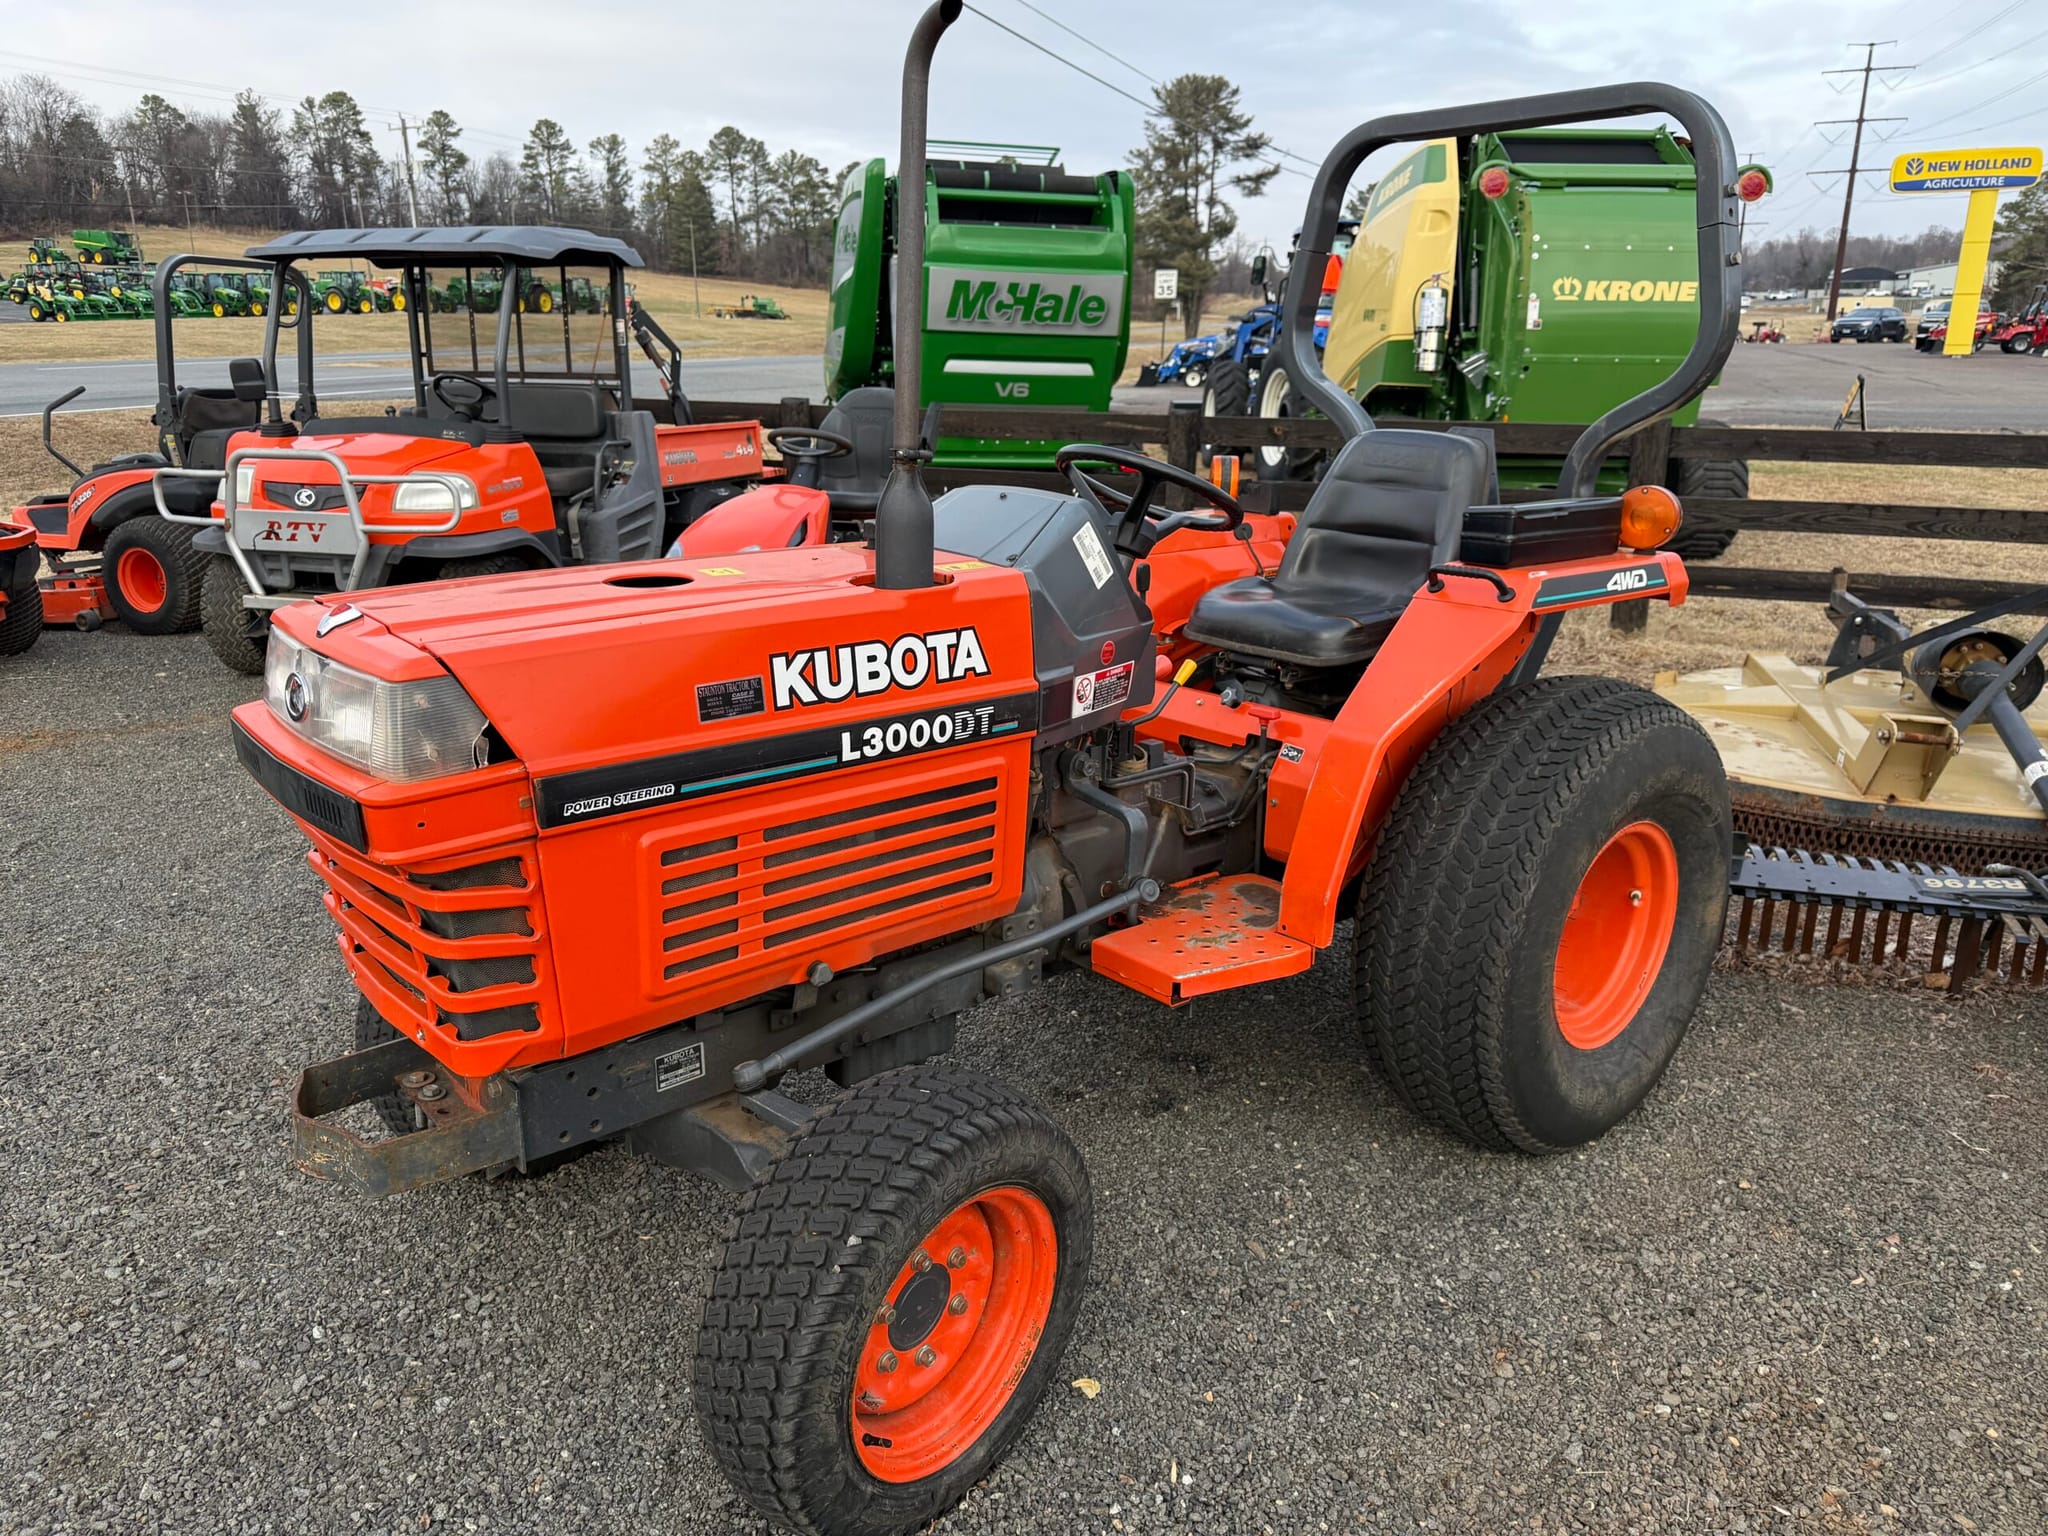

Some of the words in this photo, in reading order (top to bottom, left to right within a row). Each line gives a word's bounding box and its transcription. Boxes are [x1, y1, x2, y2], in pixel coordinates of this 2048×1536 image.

[1927, 160, 1962, 173] NEW
[1964, 157, 2033, 171] HOLLAND
[1923, 176, 2006, 189] AGRICULTURE
[945, 279, 1108, 326] McHale
[1157, 285, 1174, 297] 35
[1583, 279, 1699, 303] KRONE
[995, 381, 1030, 398] V6
[261, 520, 328, 544] RTV
[1606, 568, 1648, 592] 4WD
[770, 627, 991, 711] KUBOTA
[841, 705, 995, 763] L3000DT
[563, 796, 612, 817] POWER
[613, 783, 676, 806] STEERING
[1923, 878, 2029, 890] R3796
[664, 1048, 695, 1063] KUBOTA
